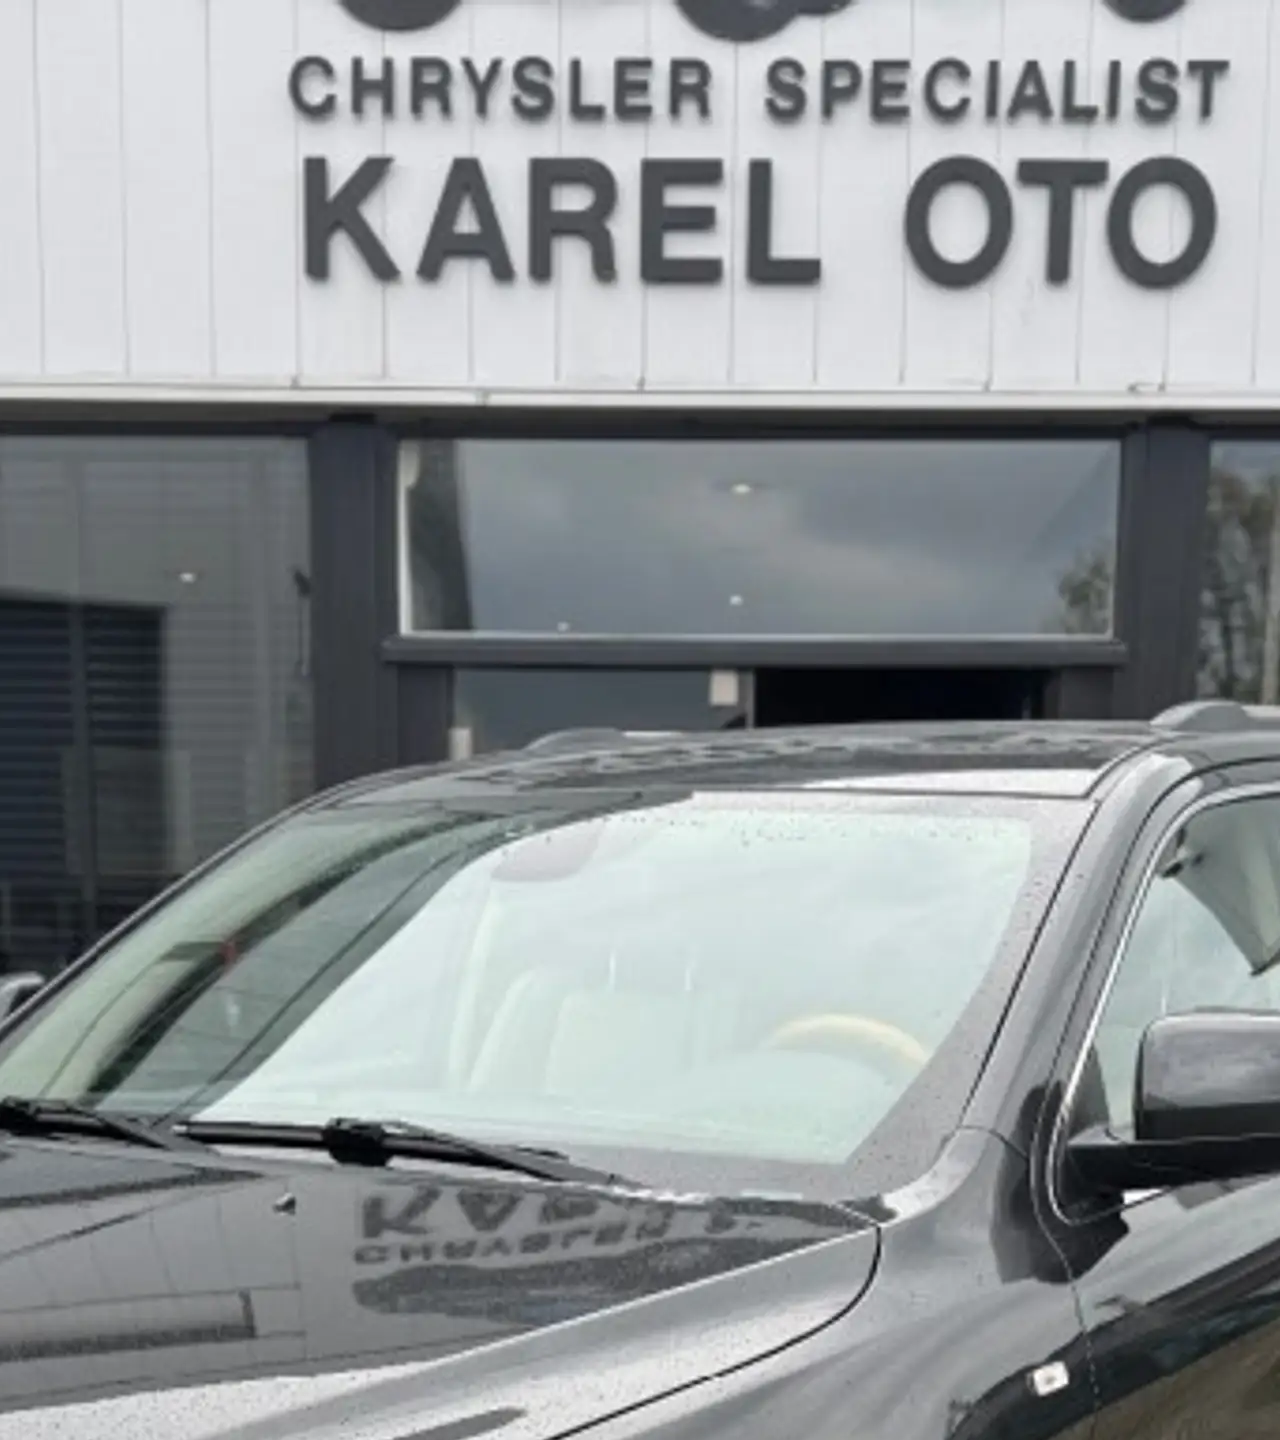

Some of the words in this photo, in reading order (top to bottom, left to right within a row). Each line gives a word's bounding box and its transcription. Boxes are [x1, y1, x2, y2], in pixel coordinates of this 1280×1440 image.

[289, 56, 712, 123] CHRYSLER
[765, 58, 1230, 124] SPECIALIST
[303, 157, 822, 287] KAREL
[903, 156, 1217, 291] OTO
